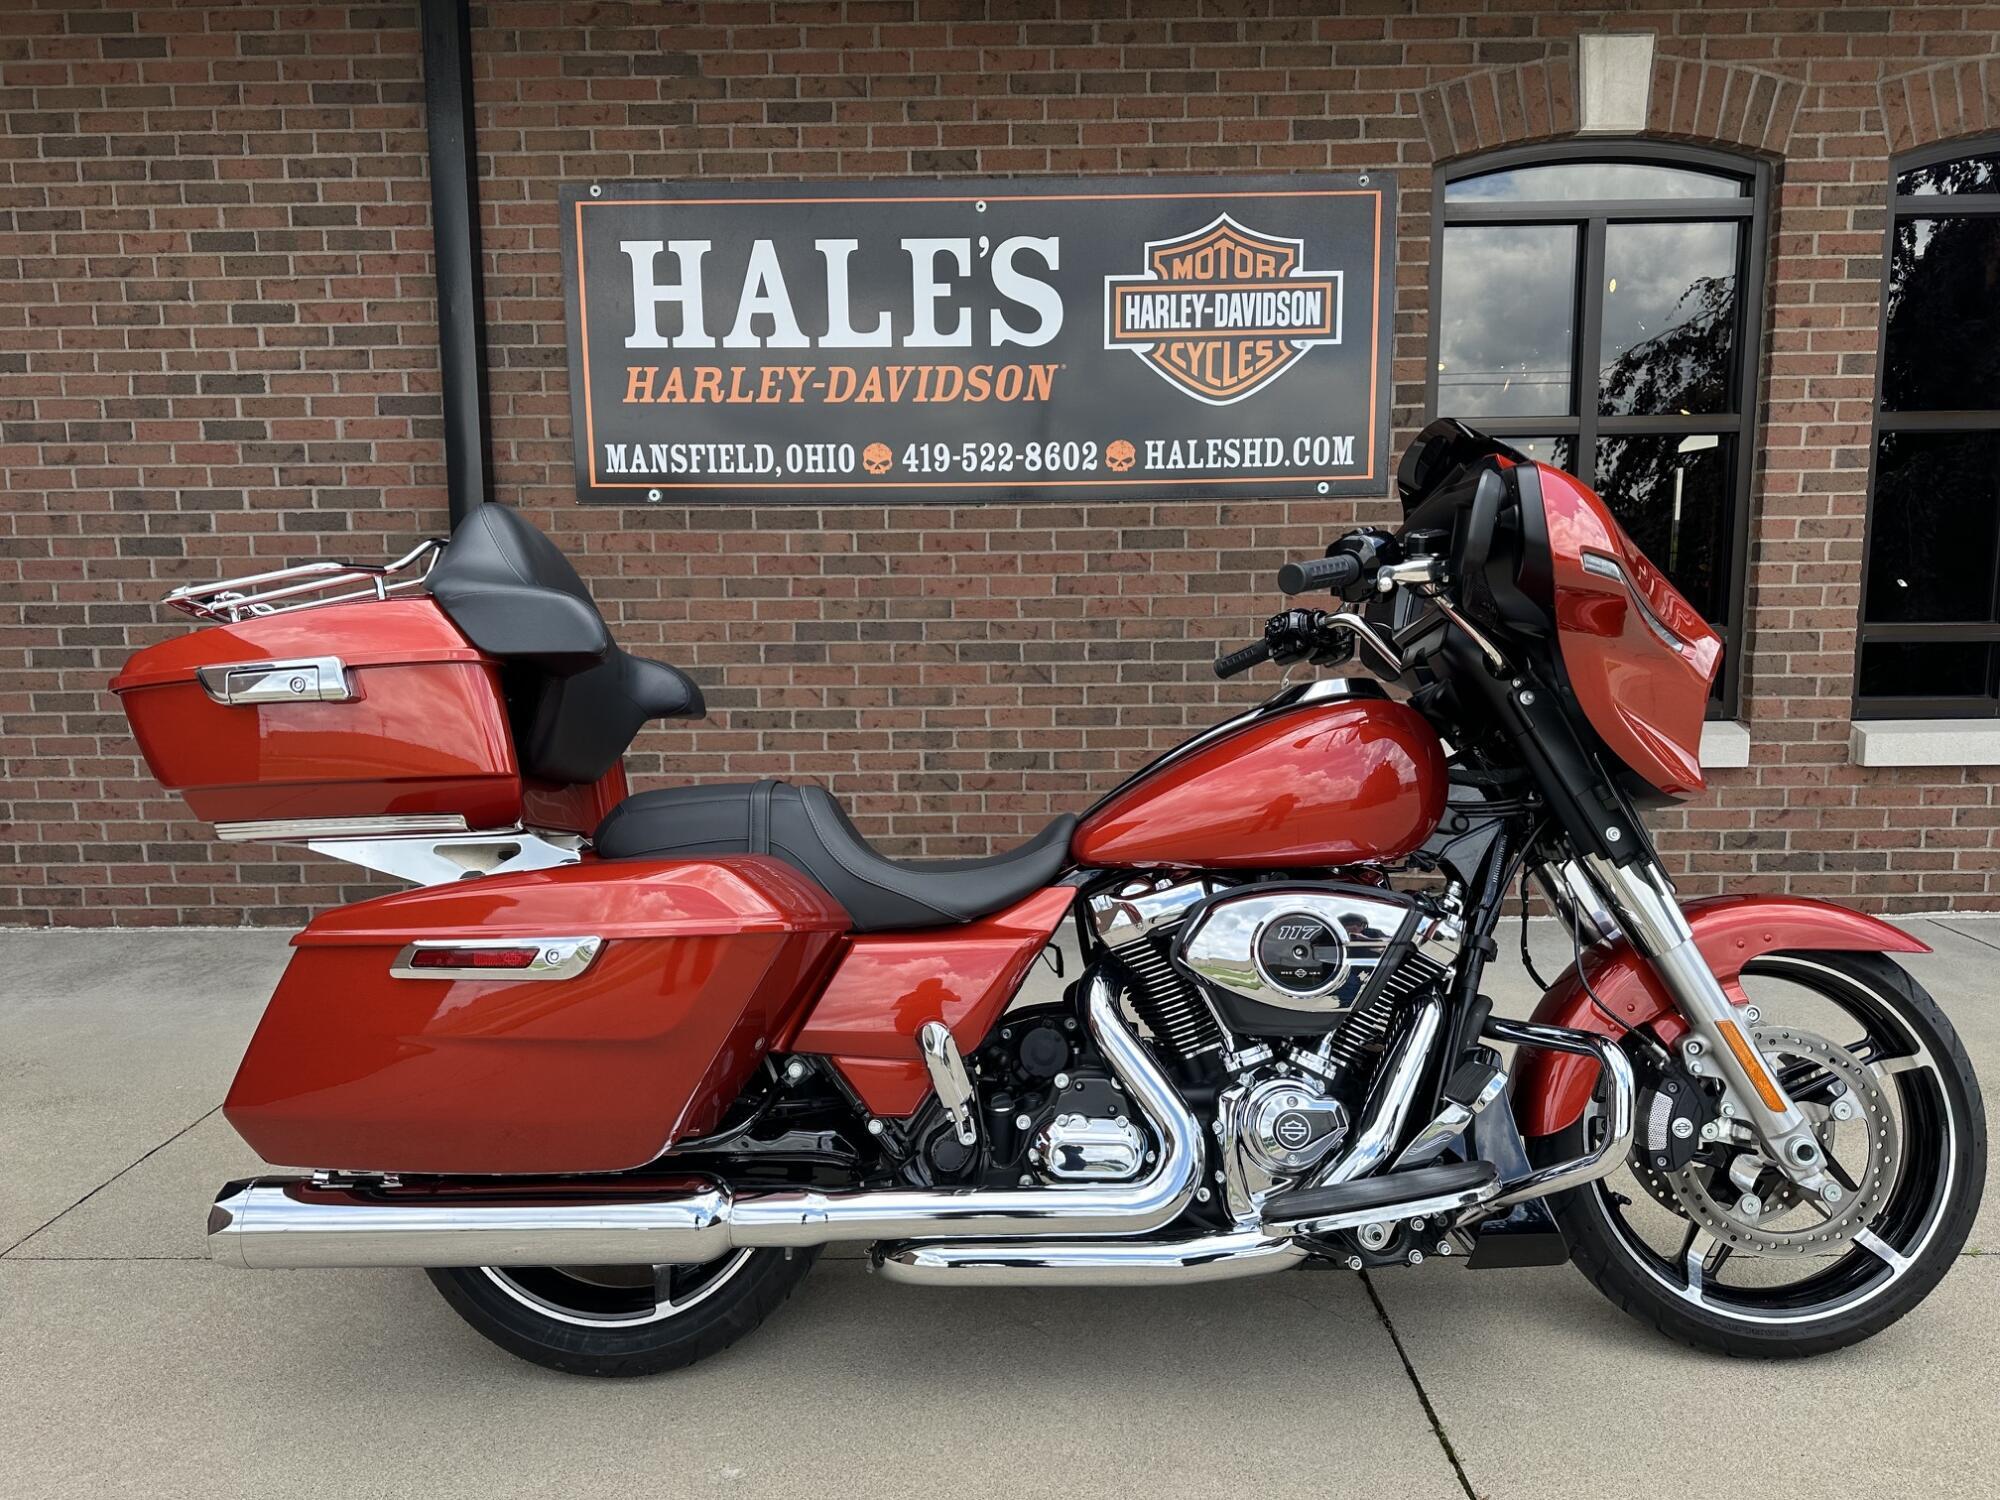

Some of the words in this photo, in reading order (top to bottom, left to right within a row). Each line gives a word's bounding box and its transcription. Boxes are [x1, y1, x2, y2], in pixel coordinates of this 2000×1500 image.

[1172, 237, 1276, 280] MOTOR
[619, 235, 1064, 349] HALE'S
[1125, 290, 1322, 330] HARLEY-DAVIDSON
[1170, 339, 1274, 387] CYCLES
[623, 364, 1059, 404] HARLEY-DAVIDSON
[902, 441, 1098, 473] 419-522-8602
[1144, 435, 1356, 470] HALESHD.COM
[1278, 925, 1323, 940] 117
